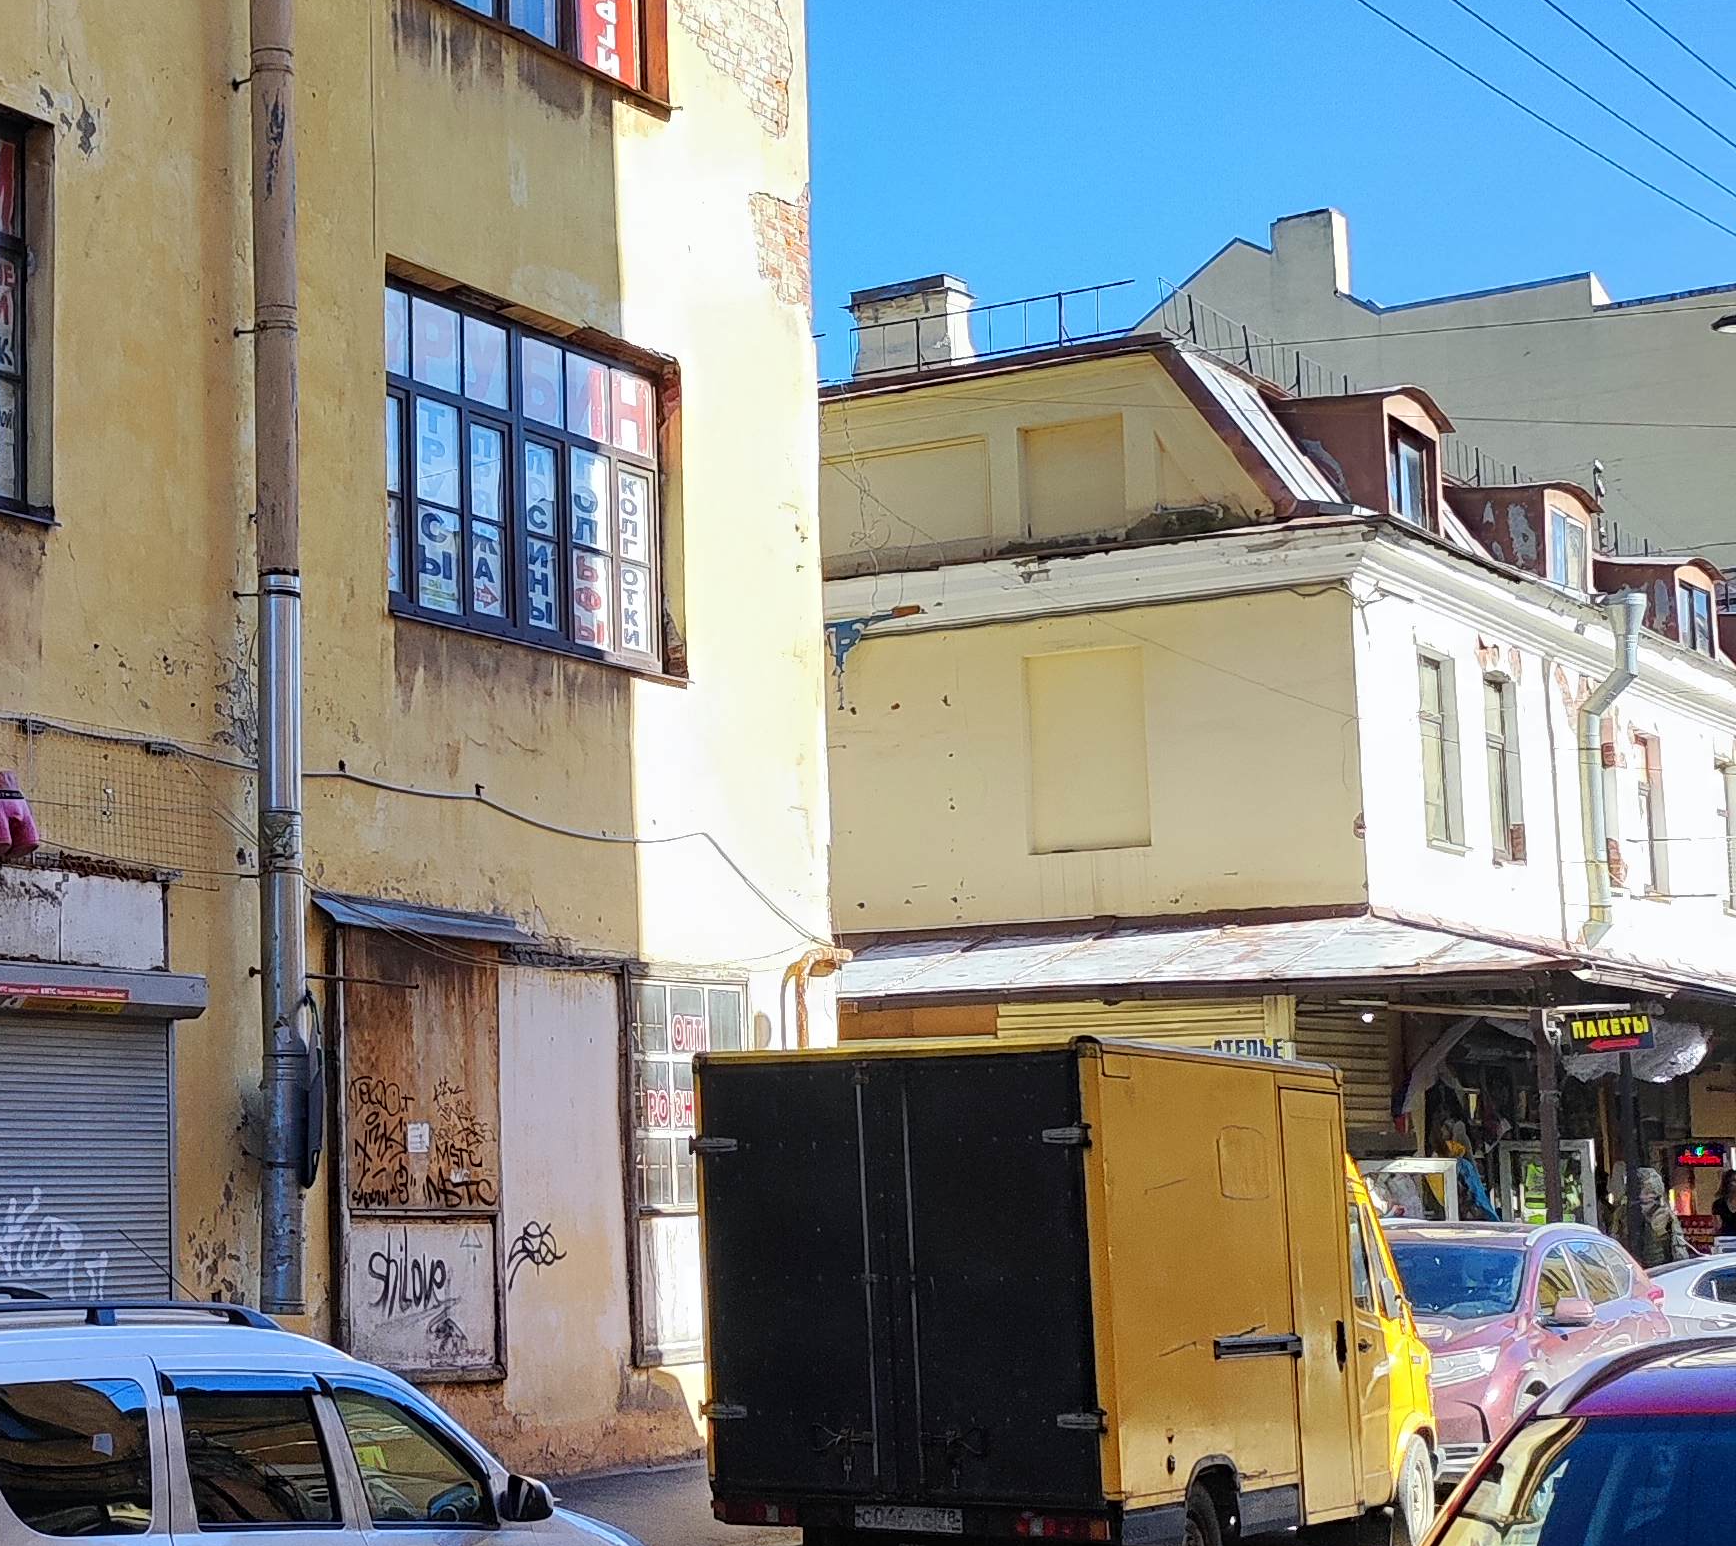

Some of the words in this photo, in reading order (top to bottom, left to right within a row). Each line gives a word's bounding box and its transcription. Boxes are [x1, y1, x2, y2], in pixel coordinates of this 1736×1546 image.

[414, 310, 652, 456] РУБИН
[418, 404, 453, 581] ТРУСЫ
[527, 449, 554, 626] ЛОСИНЫ
[573, 453, 605, 646] ГОЛЬФЫ
[620, 476, 640, 647] КОЛГОТКИ
[672, 1013, 705, 1051] ОПТ
[1571, 1015, 1649, 1040] ПАКЕТЫ
[647, 1089, 695, 1127] РОЗН
